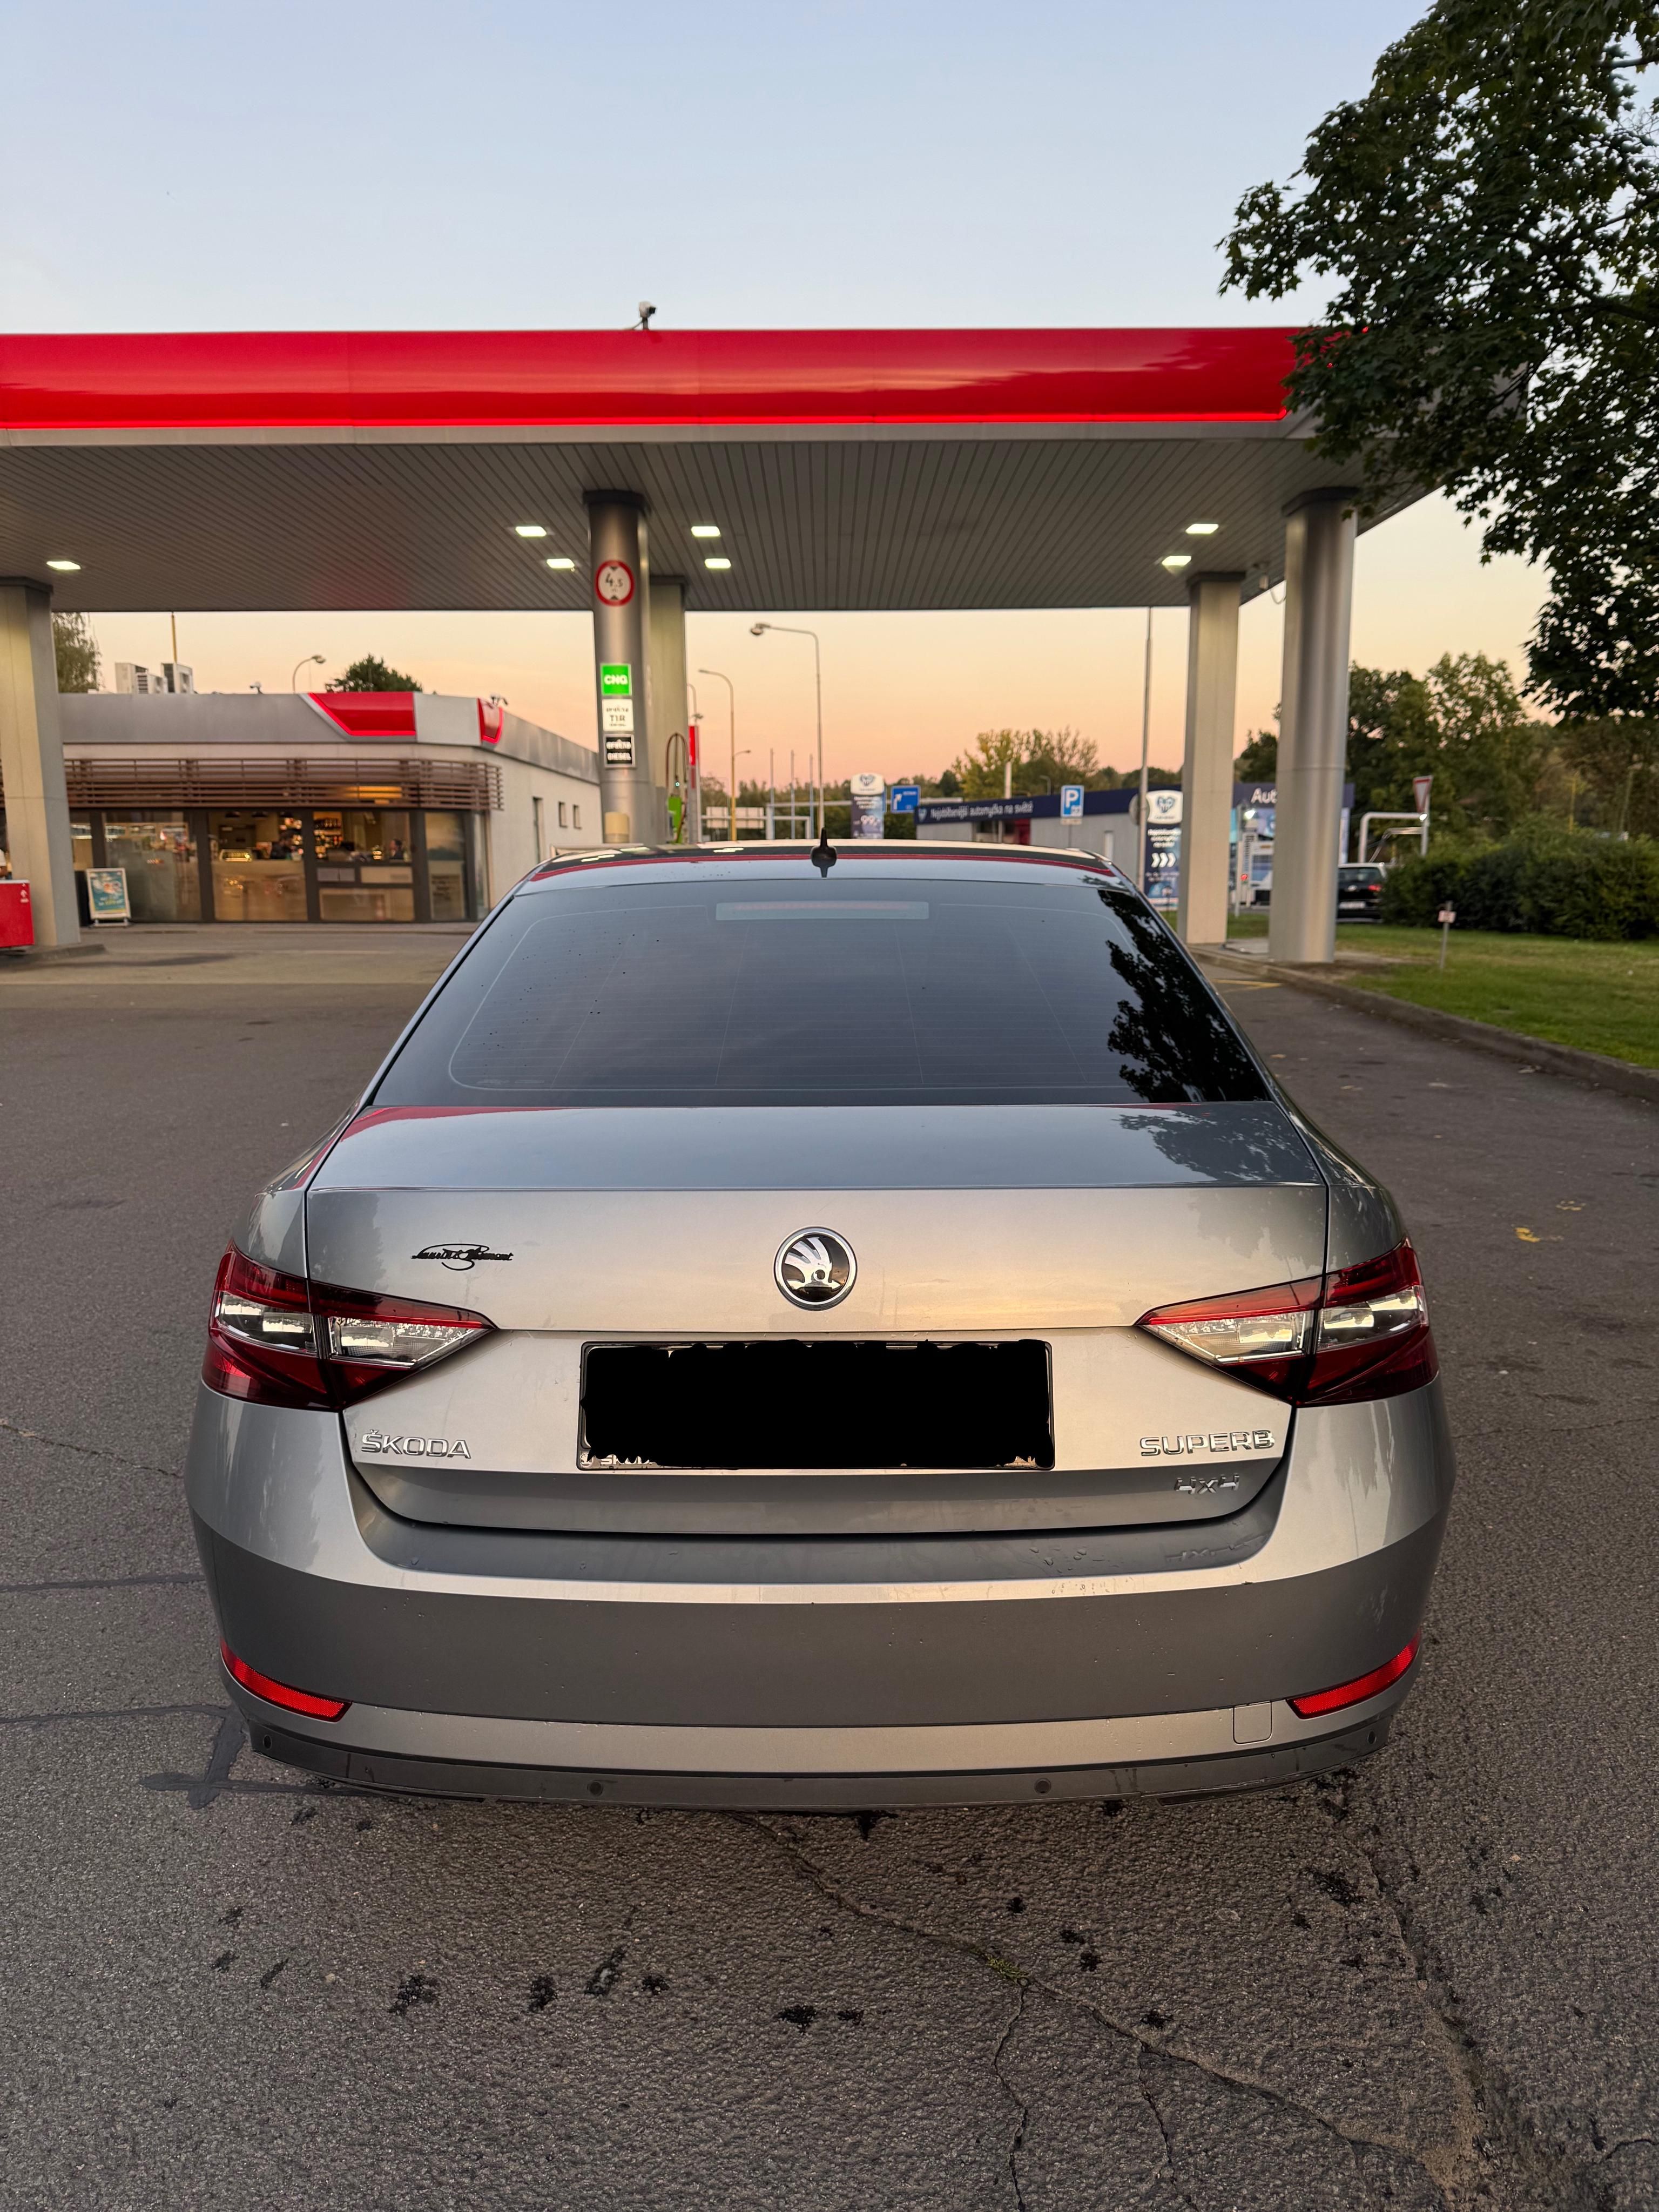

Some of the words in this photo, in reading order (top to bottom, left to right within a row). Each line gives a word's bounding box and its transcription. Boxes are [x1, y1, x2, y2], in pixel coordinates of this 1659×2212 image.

[604, 675, 628, 685] CNG
[1065, 790, 1080, 808] P
[361, 1429, 471, 1459] ŠKODA
[1140, 1430, 1275, 1456] SUPERB
